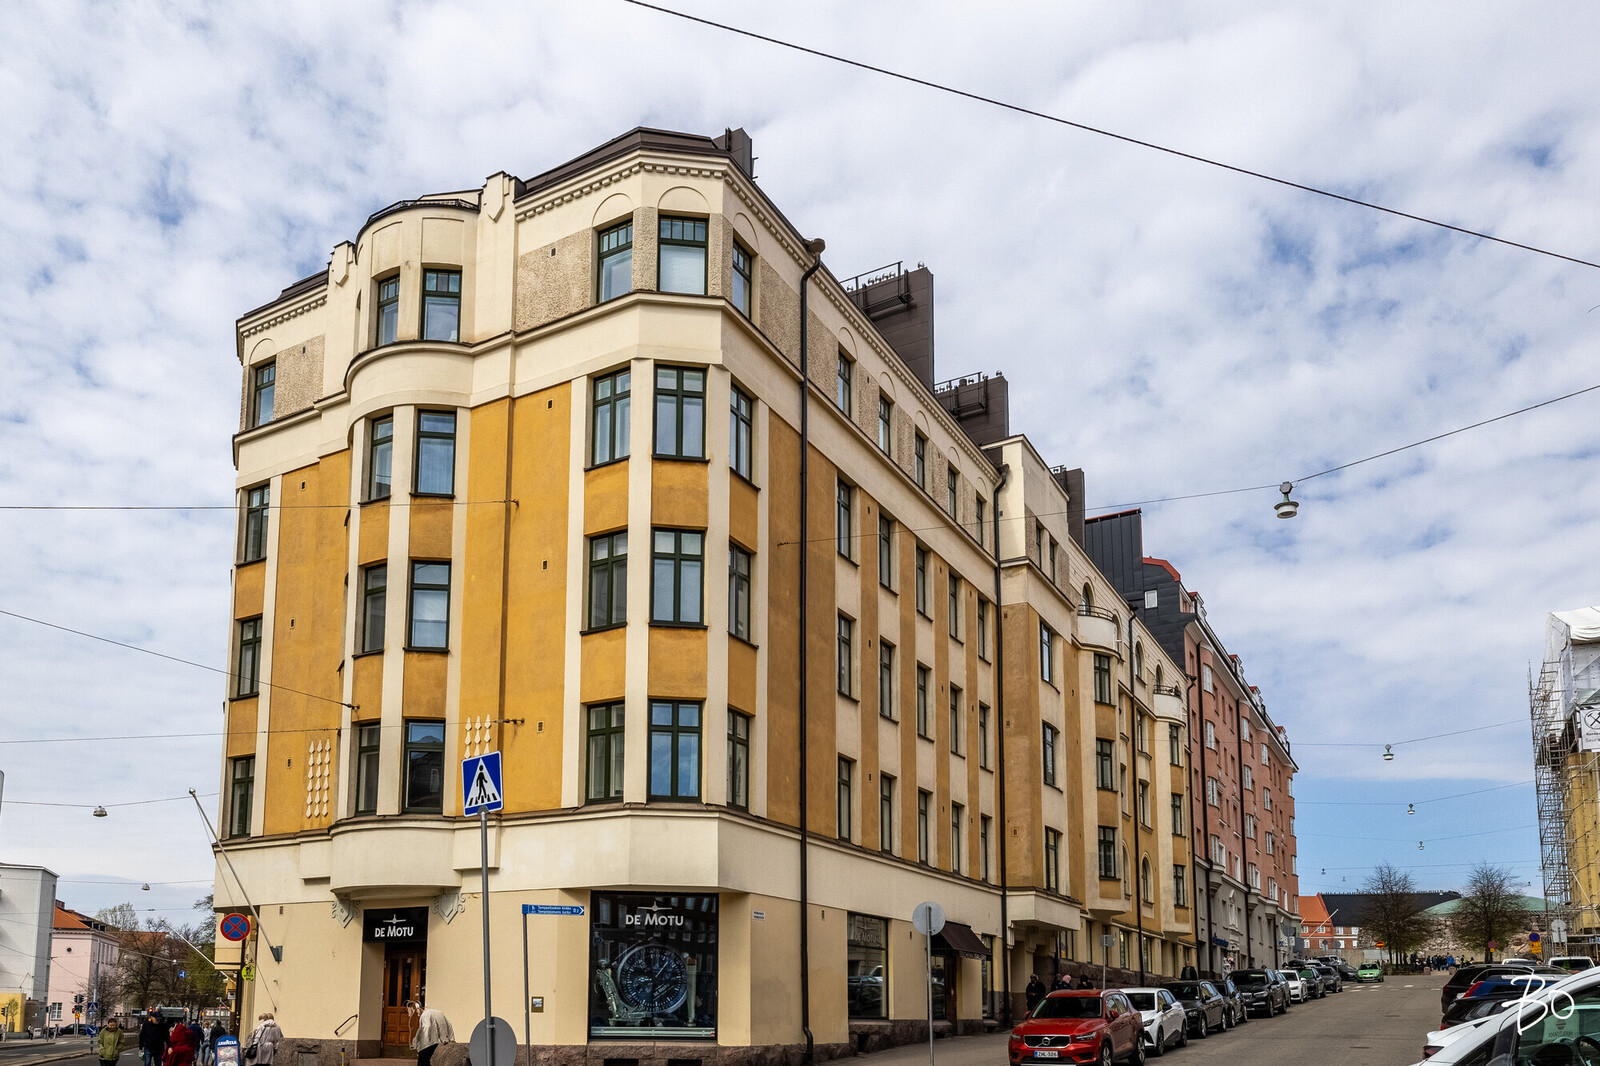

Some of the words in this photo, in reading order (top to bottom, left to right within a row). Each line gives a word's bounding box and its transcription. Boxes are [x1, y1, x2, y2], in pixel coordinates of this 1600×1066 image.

[624, 914, 640, 924] DE
[645, 913, 684, 926] MOTU
[374, 928, 386, 938] DE
[387, 926, 414, 937] MOTU
